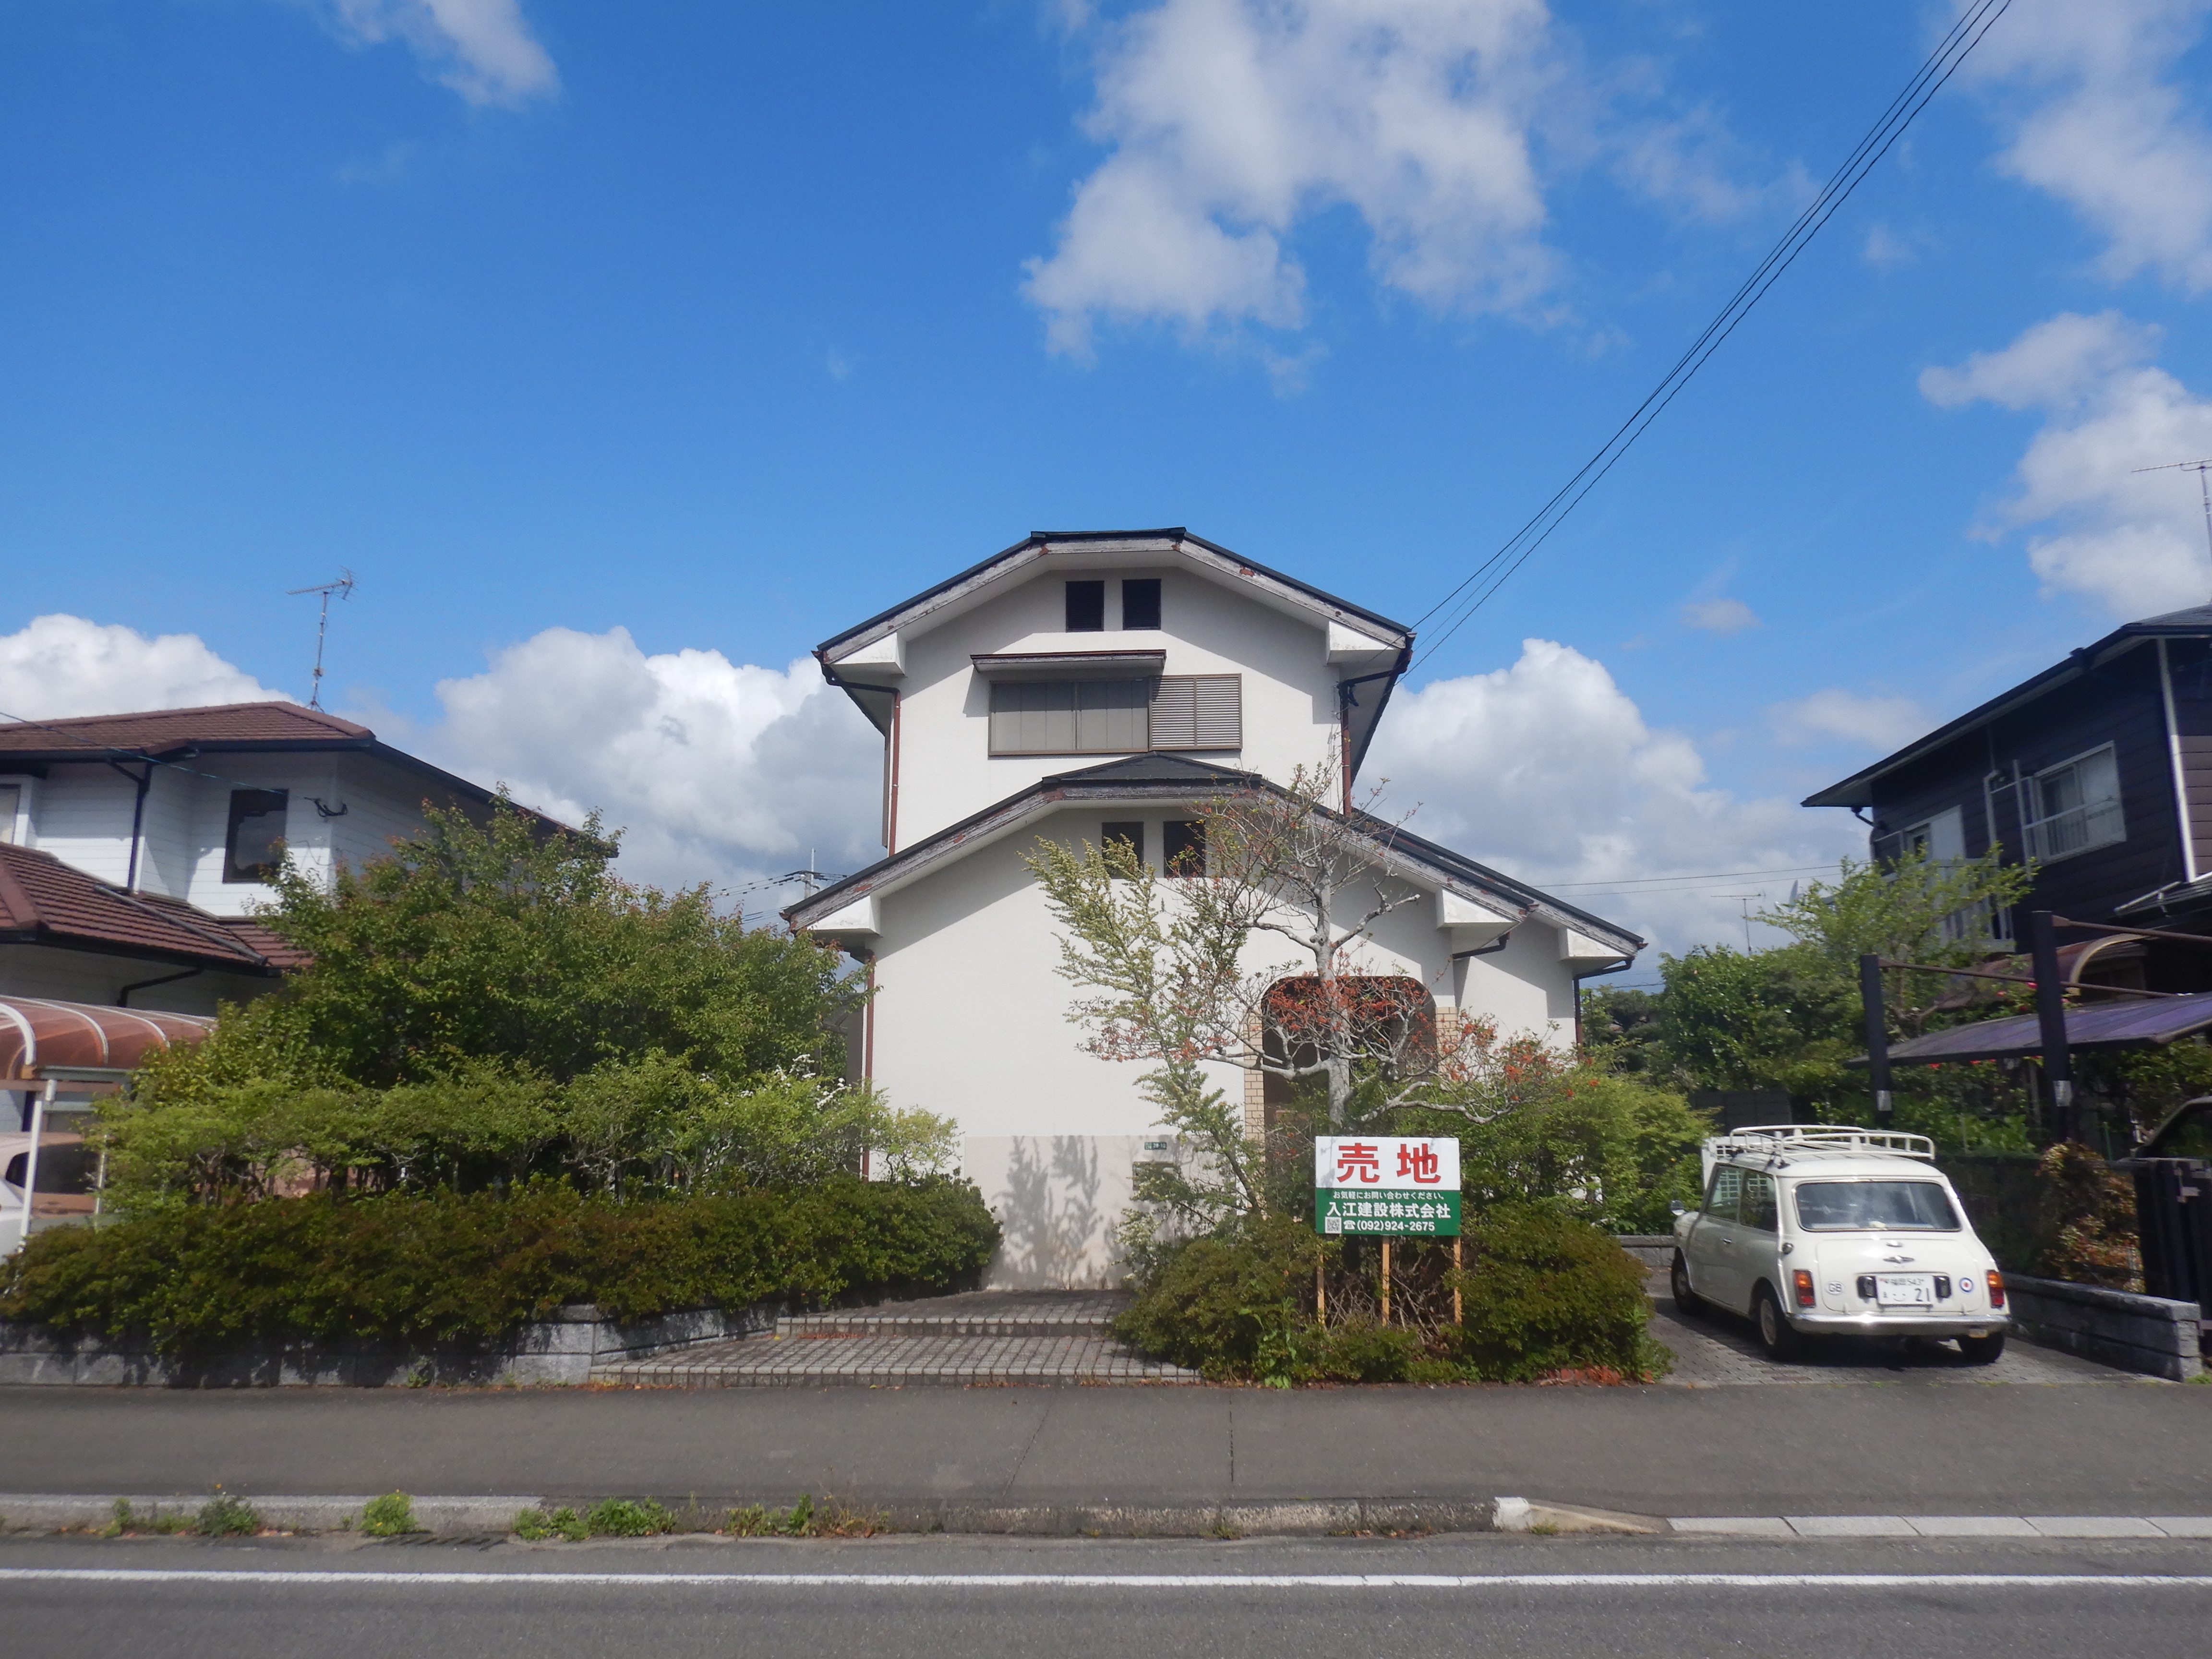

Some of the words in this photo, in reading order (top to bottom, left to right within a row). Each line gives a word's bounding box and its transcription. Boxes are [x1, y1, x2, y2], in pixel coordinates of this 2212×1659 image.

[1337, 1143, 1442, 1183] 売地
[1333, 1191, 1445, 1200] お気軽にお問い合わせください。
[1327, 1202, 1451, 1218] 入江建設株式会社
[1357, 1220, 1435, 1232] (092)924-2675
[1828, 1283, 1842, 1292] GB
[1914, 1288, 1930, 1302] 21
